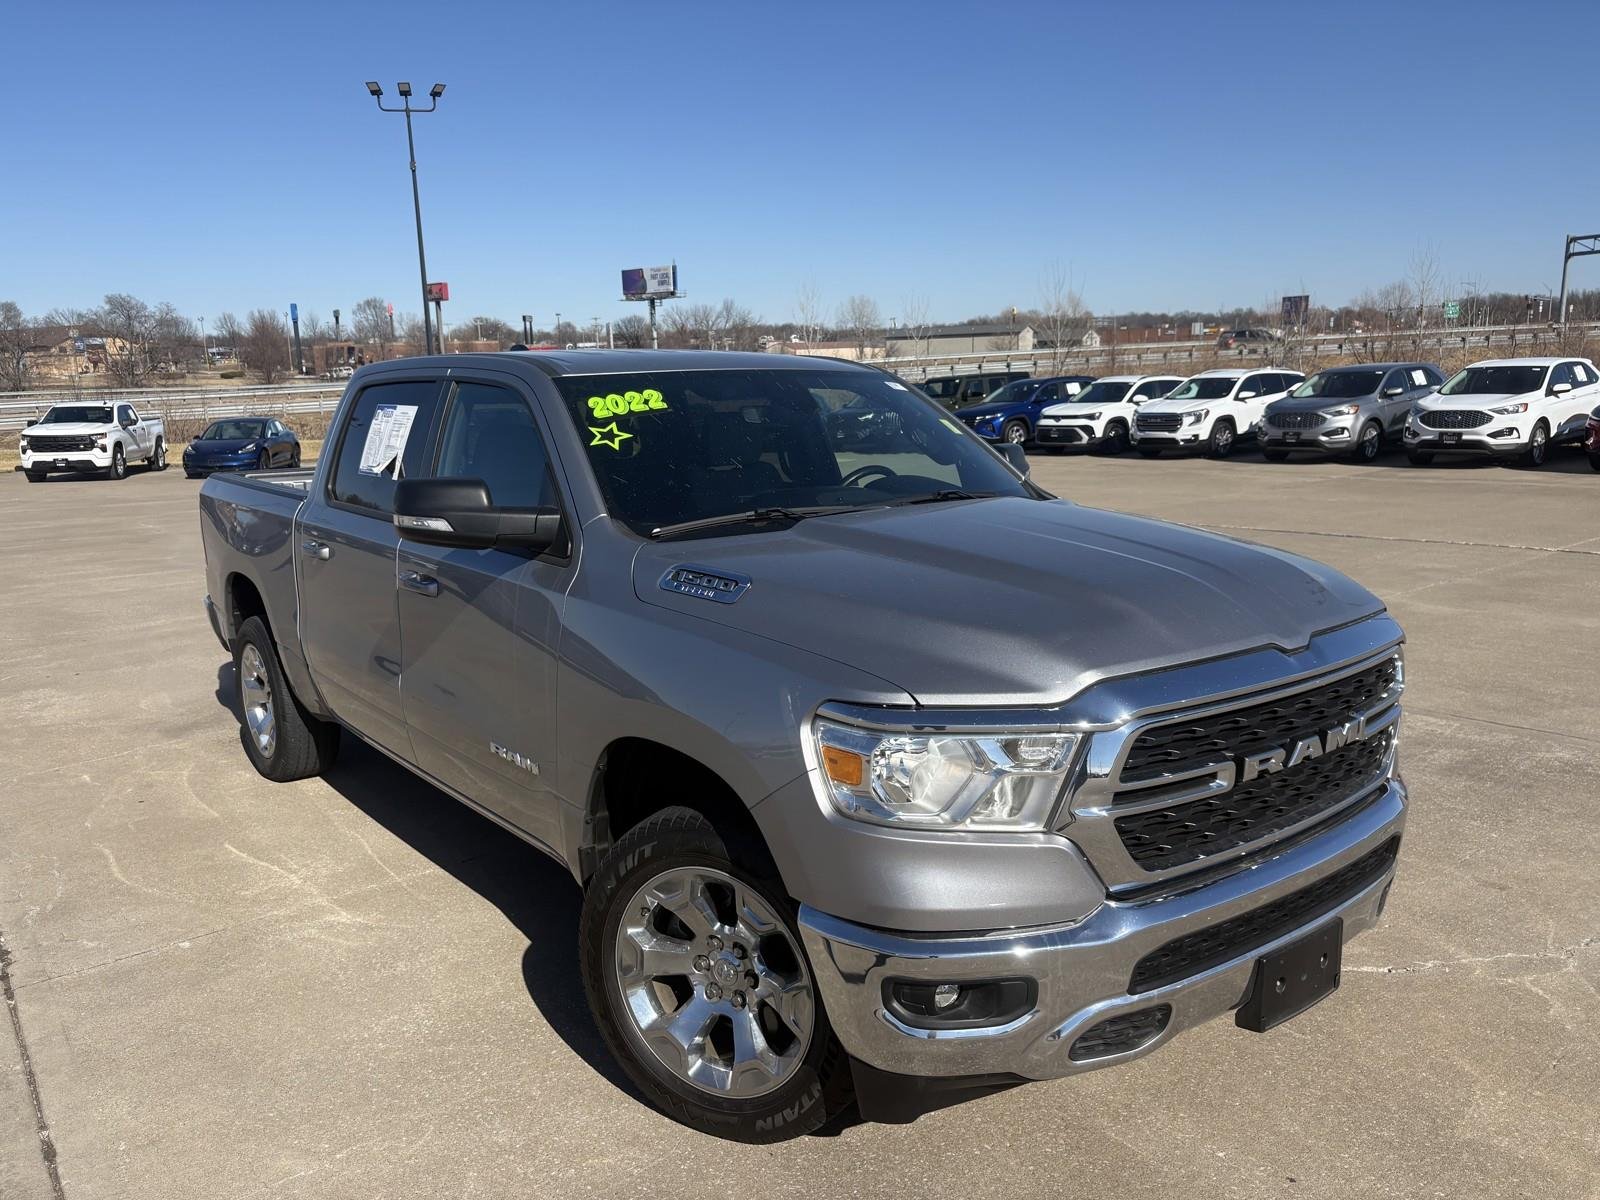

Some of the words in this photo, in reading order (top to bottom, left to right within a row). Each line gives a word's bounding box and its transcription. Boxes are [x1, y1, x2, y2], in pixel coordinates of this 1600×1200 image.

[588, 389, 668, 419] 2022
[677, 568, 739, 593] 1500
[1243, 716, 1361, 782] RAM
